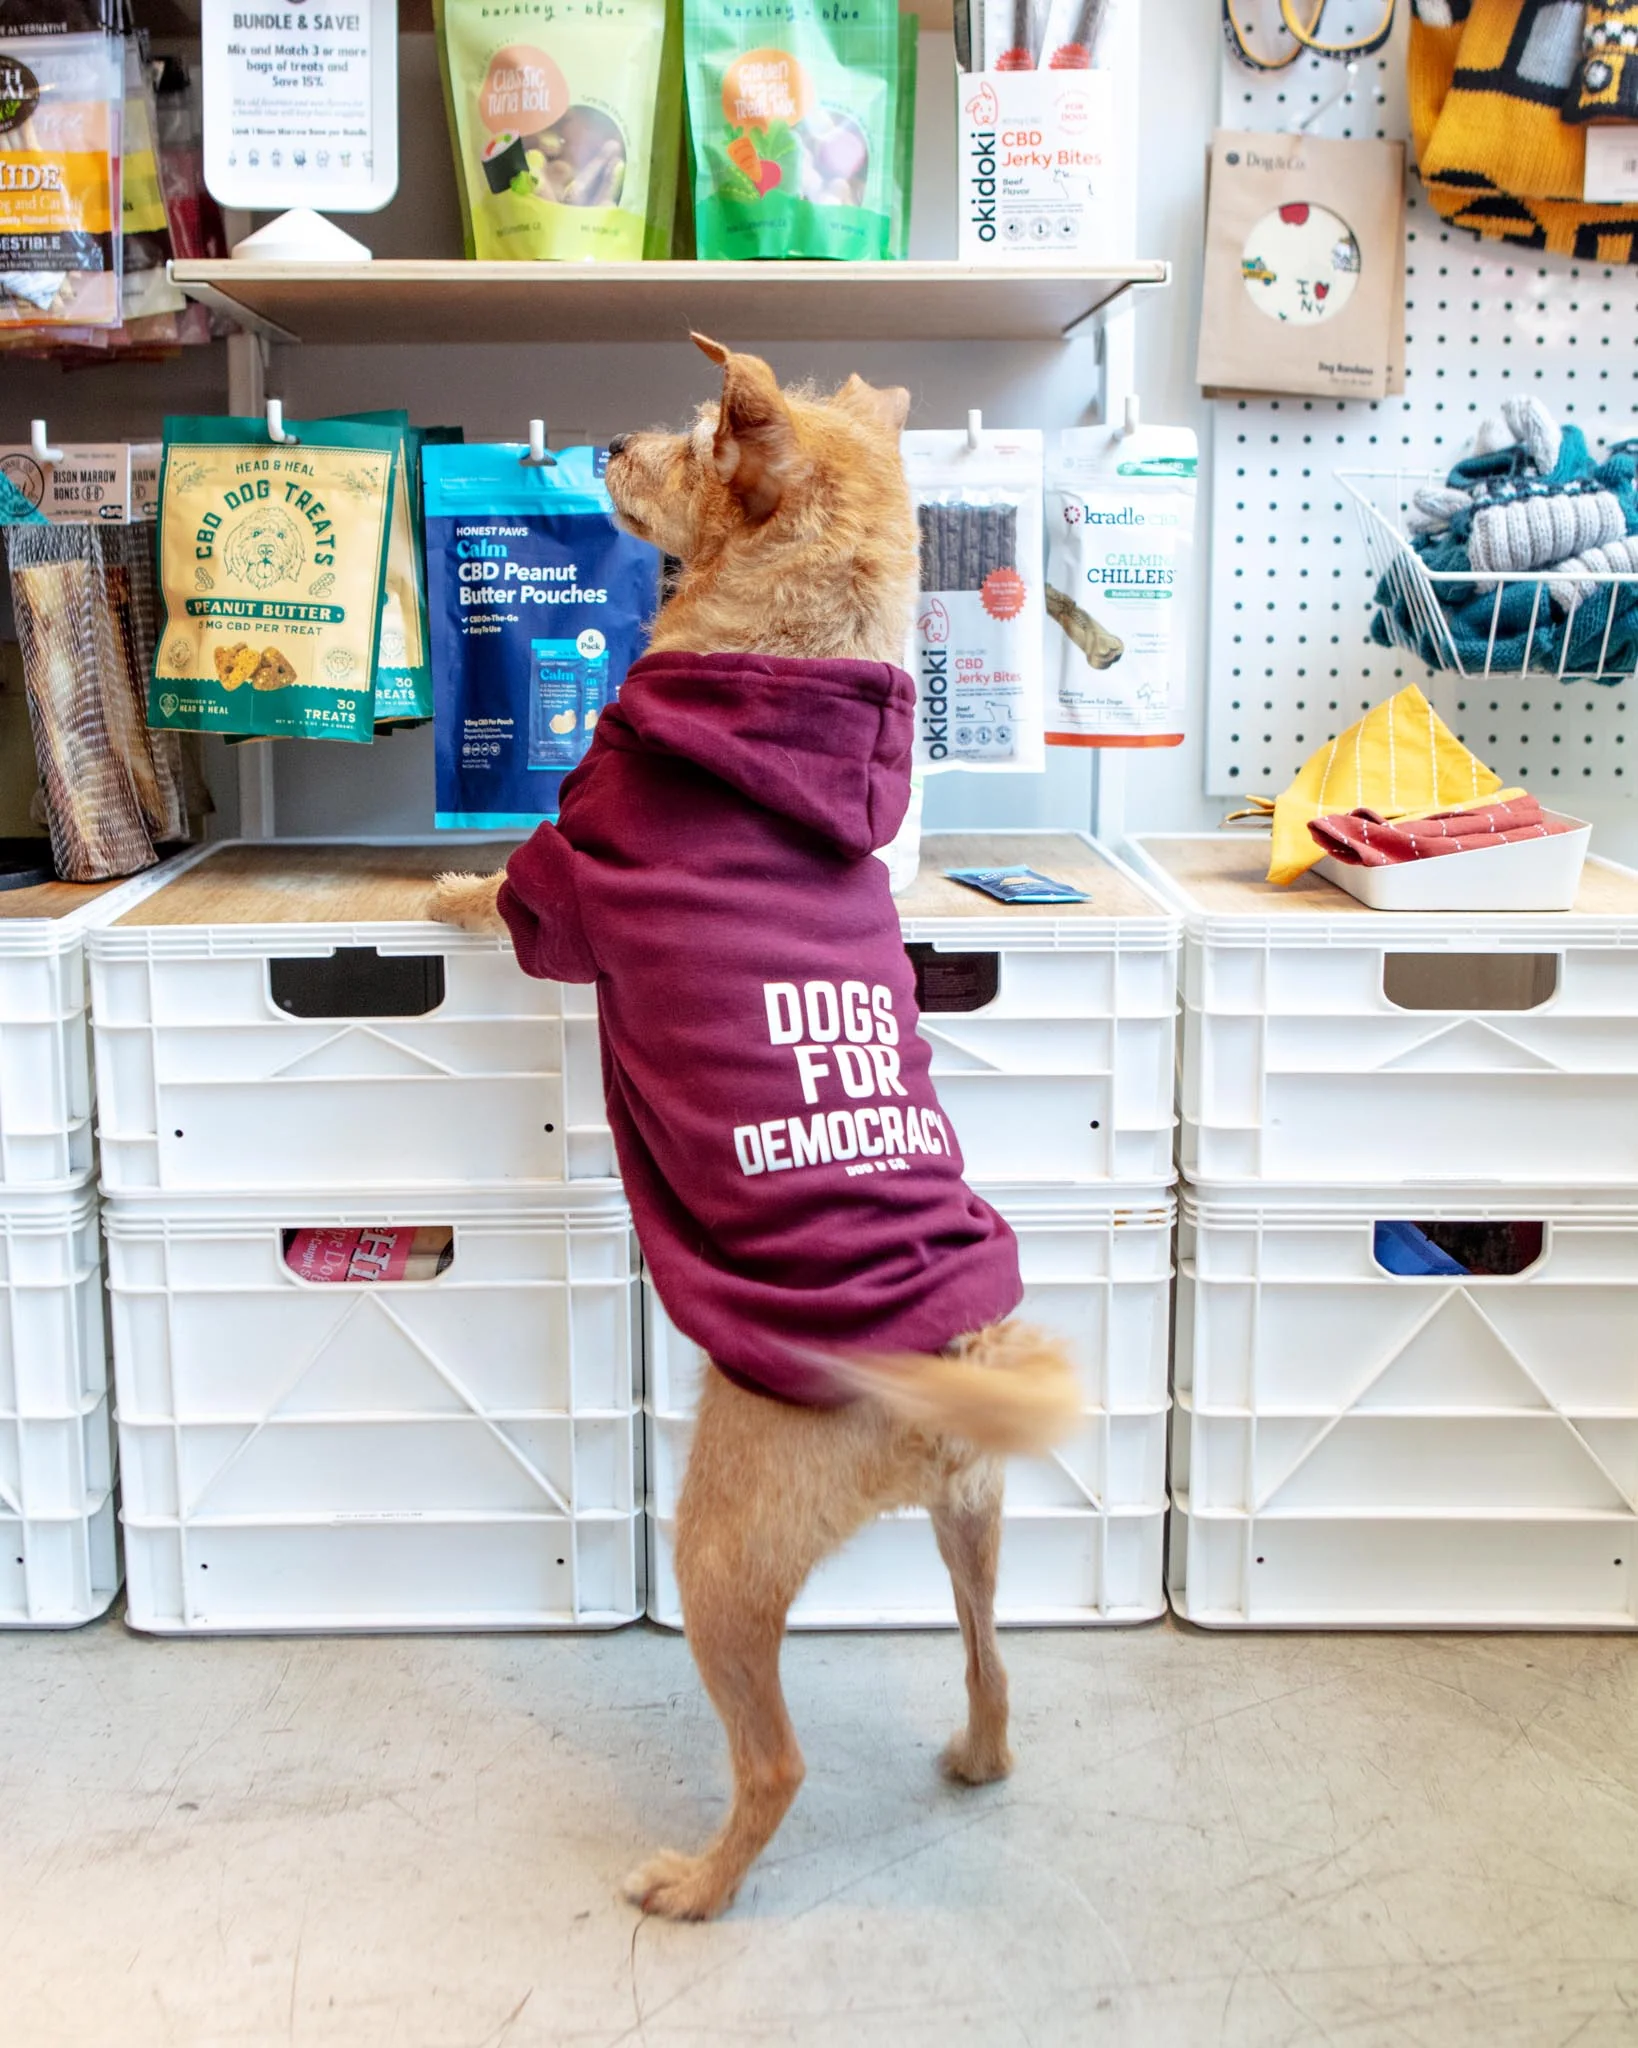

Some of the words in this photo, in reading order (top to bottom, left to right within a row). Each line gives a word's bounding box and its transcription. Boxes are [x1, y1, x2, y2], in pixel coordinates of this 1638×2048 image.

[482, 5, 554, 22] barkley
[586, 1, 624, 17] blue
[723, 5, 795, 21] barkley
[822, 3, 859, 23] blue
[8, 22, 68, 36] ALTERNATIVE
[233, 14, 292, 30] BUNDLE
[298, 14, 308, 30] &
[314, 15, 360, 31] SAVE!
[227, 44, 246, 56] Mix
[250, 44, 271, 56] and
[275, 45, 309, 57] Match
[312, 45, 319, 57] 3
[322, 48, 333, 57] or
[337, 49, 367, 57] more
[246, 60, 273, 74] bags
[276, 60, 287, 72] of
[290, 61, 324, 72] treats
[327, 61, 348, 72] and
[272, 76, 298, 87] Save
[302, 76, 323, 87] 15%
[1002, 131, 1042, 147] CBD
[1002, 151, 1052, 170] Jerky
[1058, 150, 1102, 166] Bites
[971, 132, 996, 242] okidoki
[0, 236, 60, 250] ESTIBLE
[236, 459, 270, 475] HEAD
[273, 459, 281, 471] &
[284, 461, 315, 476] HEAL
[53, 470, 78, 484] BISON
[80, 470, 116, 484] MARROW
[53, 487, 79, 501] BONES
[196, 511, 222, 560] CBD
[223, 479, 270, 510] DOG
[284, 481, 336, 567] TREATS
[1084, 506, 1145, 526] kradle
[456, 527, 497, 537] HONEST
[499, 526, 528, 537] PAWS
[457, 539, 508, 558] Calm
[1105, 553, 1174, 567] CALMIN
[458, 562, 499, 582] CBD
[504, 562, 577, 581] Peanut
[1088, 567, 1174, 583] CHILLERS
[459, 586, 516, 606] Butter
[520, 585, 608, 604] Pouches
[194, 599, 255, 616] PEANUT
[262, 603, 331, 620] BUTTER
[205, 620, 223, 630] MG
[226, 621, 251, 632] CBD
[255, 623, 280, 634] PER
[284, 625, 323, 636] TREAT
[580, 641, 601, 650] Pack
[955, 658, 984, 670] CBD
[540, 667, 575, 681] Calm
[955, 672, 990, 685] Jerky
[993, 671, 1022, 683] Bites
[395, 677, 413, 688] 30
[375, 689, 415, 700] REATS
[179, 705, 197, 715] HEAD
[208, 706, 229, 716] HEAL
[337, 699, 356, 711] 30
[922, 648, 948, 760] okidoki
[304, 709, 356, 723] TREATS
[763, 980, 899, 1045] DOGS
[793, 1045, 908, 1104] FOR
[733, 1106, 951, 1176] DEMOCRACY
